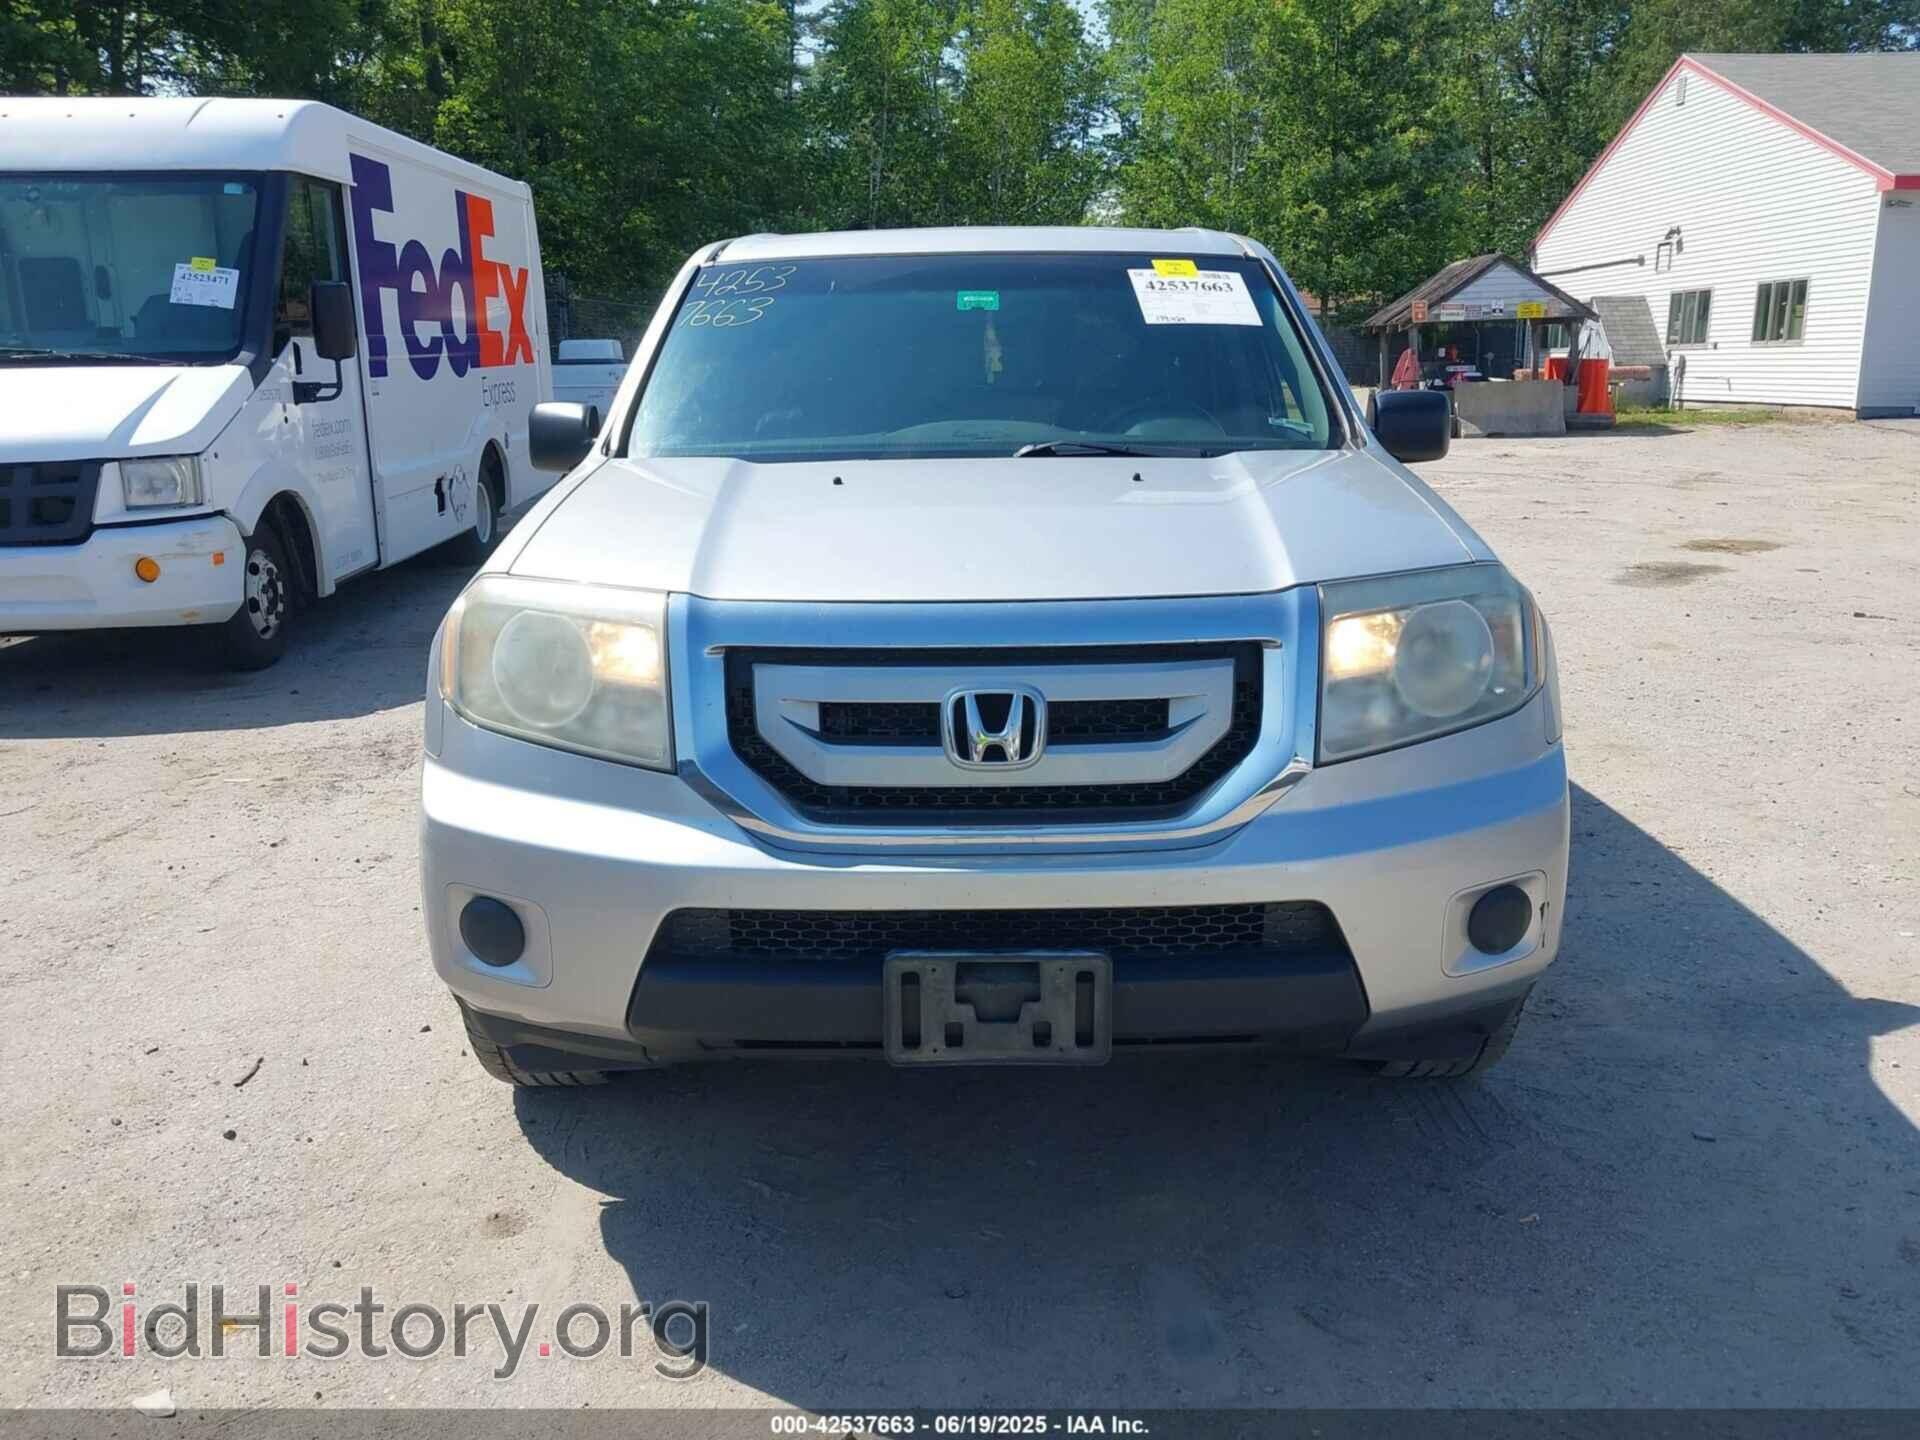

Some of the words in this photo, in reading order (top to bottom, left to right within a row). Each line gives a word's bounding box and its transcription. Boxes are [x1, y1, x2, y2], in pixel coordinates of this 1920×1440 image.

[350, 153, 534, 380] FedEx
[1145, 280, 1233, 292] 42537663
[679, 296, 774, 327] 7663
[481, 376, 516, 407] Express
